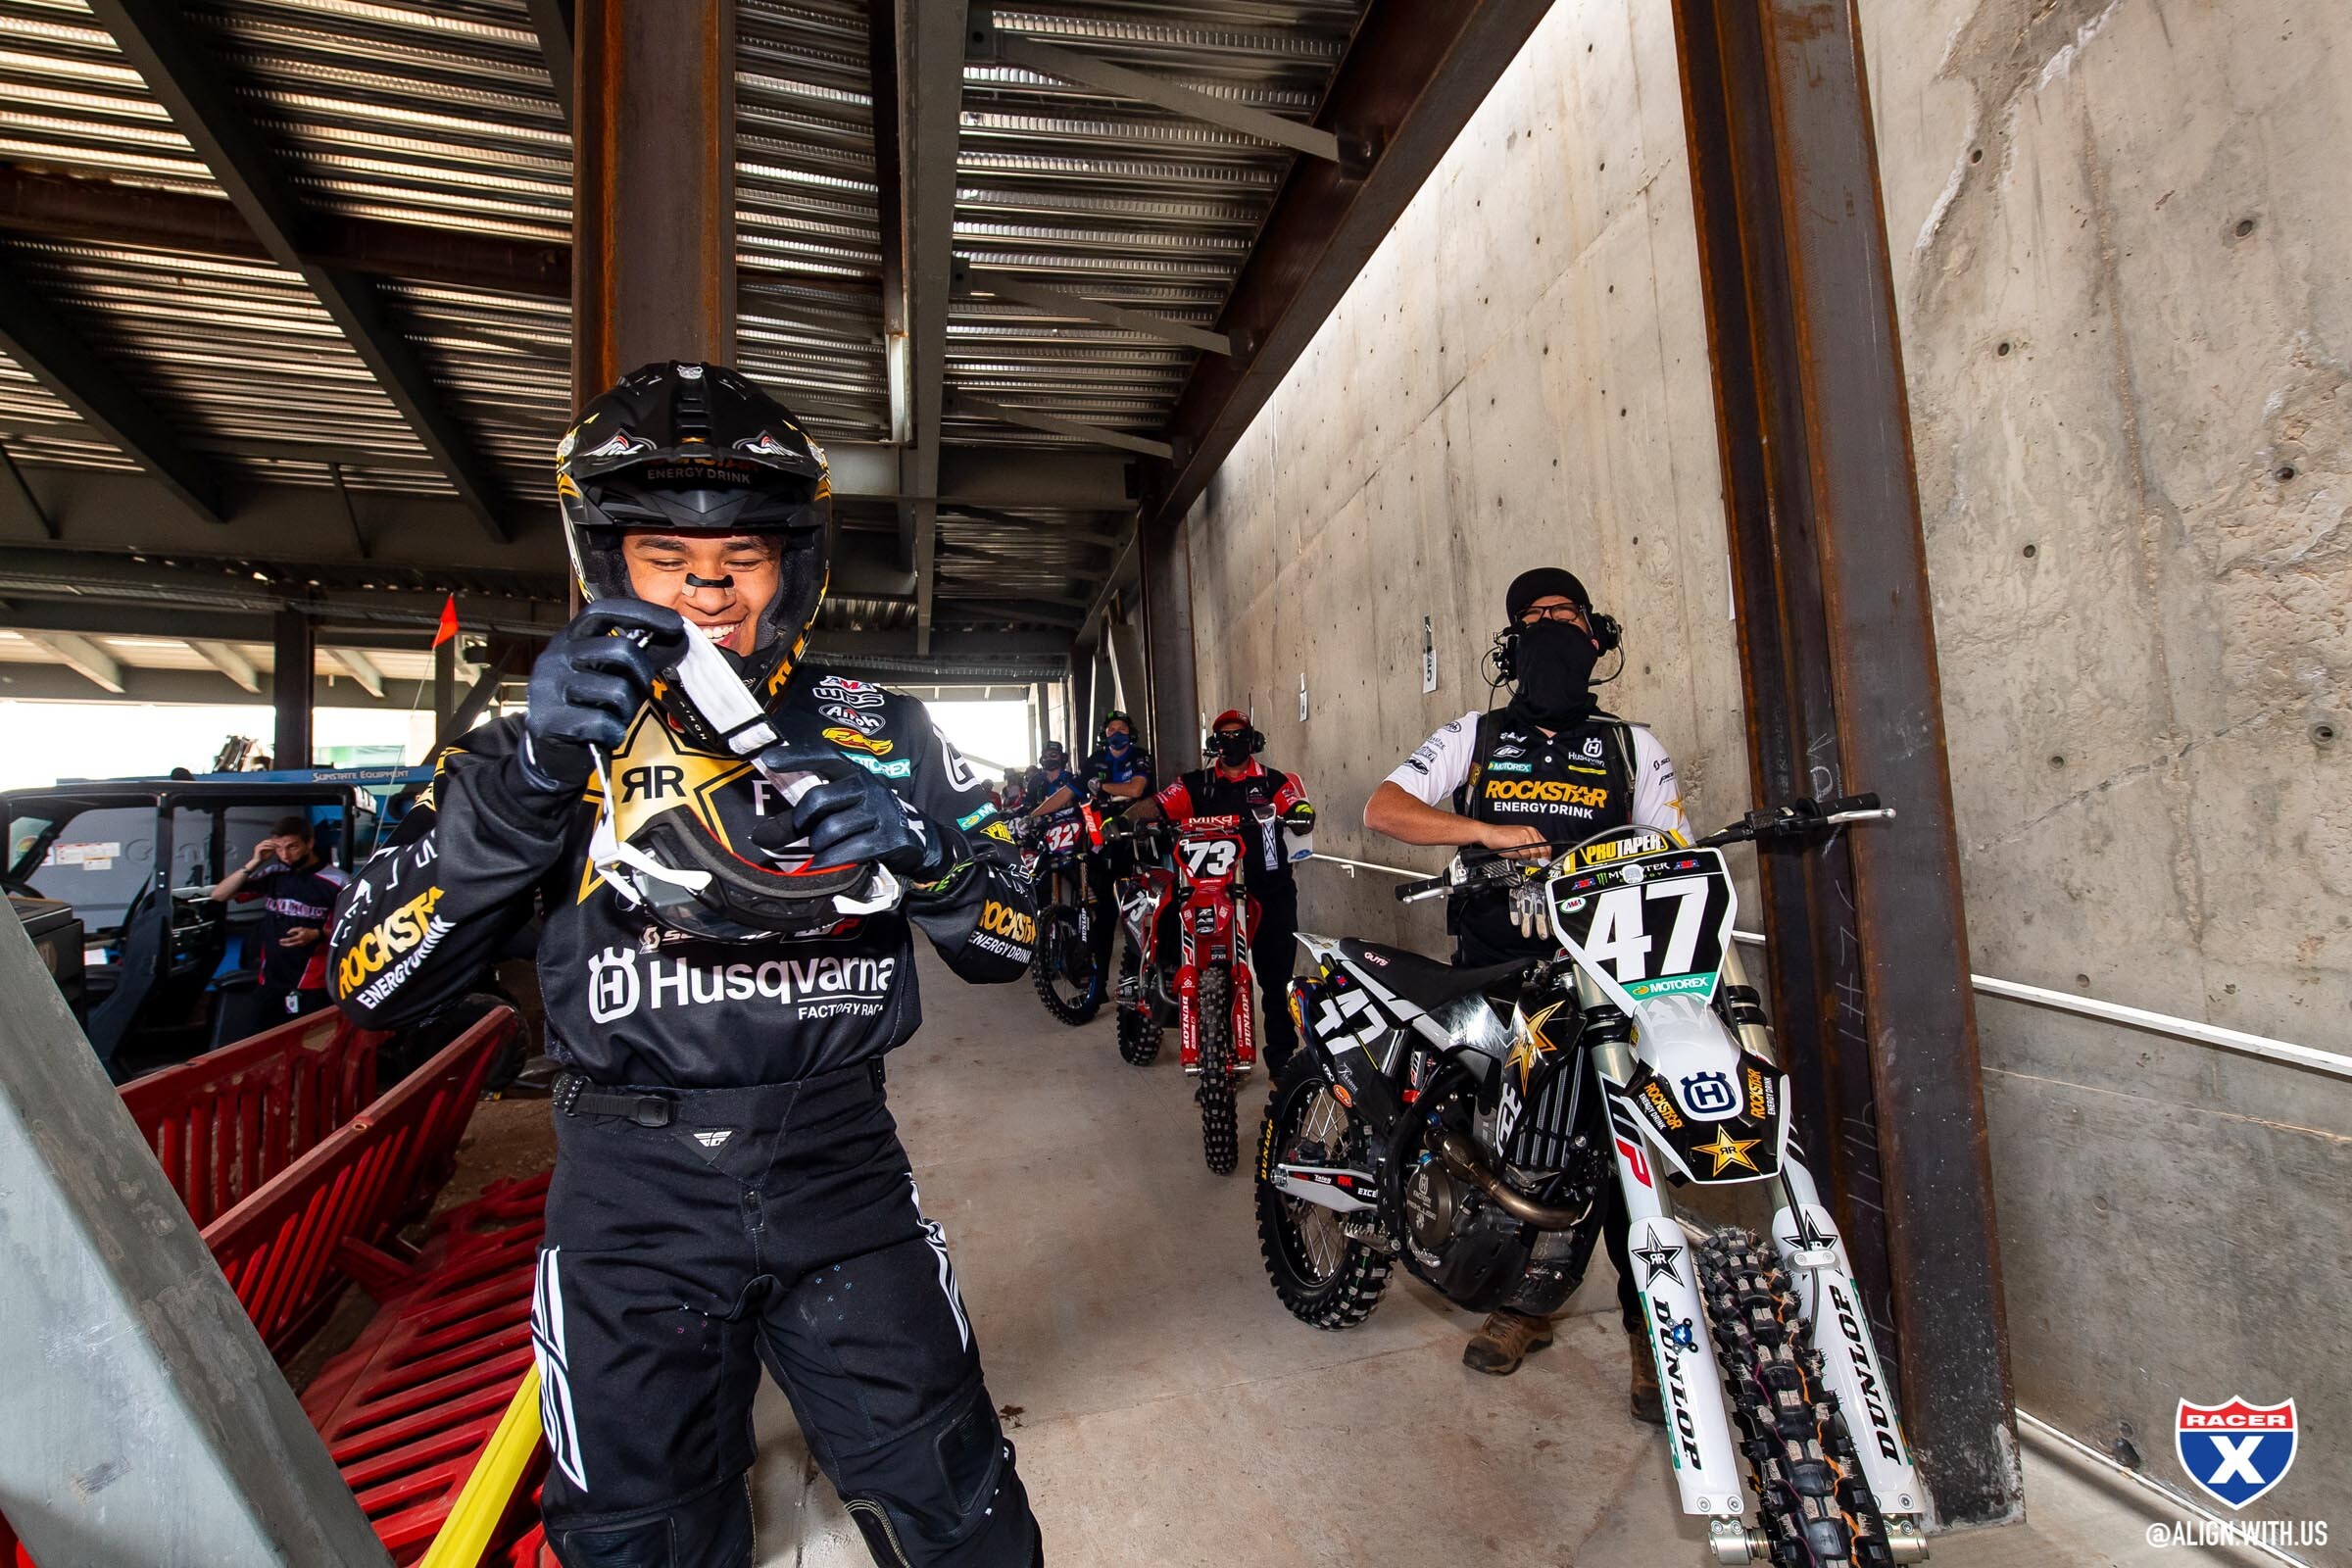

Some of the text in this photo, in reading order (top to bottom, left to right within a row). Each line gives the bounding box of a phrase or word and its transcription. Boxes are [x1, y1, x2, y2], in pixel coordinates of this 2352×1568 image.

[647, 466, 752, 484] ENERGY DRINK
[845, 754, 911, 777] OTOREX
[1493, 761, 1530, 773] MOTOREX
[1485, 781, 1608, 808] ROCKSTAR
[1494, 802, 1593, 820] ENERGY DRINK
[1050, 823, 1080, 852] 32
[1586, 834, 1665, 861] PROTAPER
[1183, 840, 1237, 875] 73
[1584, 876, 1709, 983] 47
[1363, 951, 1389, 967] GUTS
[649, 956, 896, 1009] Husqvarna
[1649, 976, 1709, 994] MOTOREX
[798, 1002, 860, 1020] FACTORY
[1182, 995, 1191, 1050] DUNLOP
[1241, 994, 1252, 1048] DUNLOP
[1643, 1081, 1685, 1131] ROCKSTAR
[1746, 1067, 1767, 1120] ROCKSTAR
[1763, 1076, 1777, 1116] ENERGY DRINK
[1638, 1093, 1667, 1130] ENERGY DRINK
[1260, 1118, 1274, 1181] DUNLOP
[1337, 1175, 1353, 1187] RK
[1652, 1296, 1702, 1470] DUNLOP
[1829, 1284, 1901, 1466] DUNLOP
